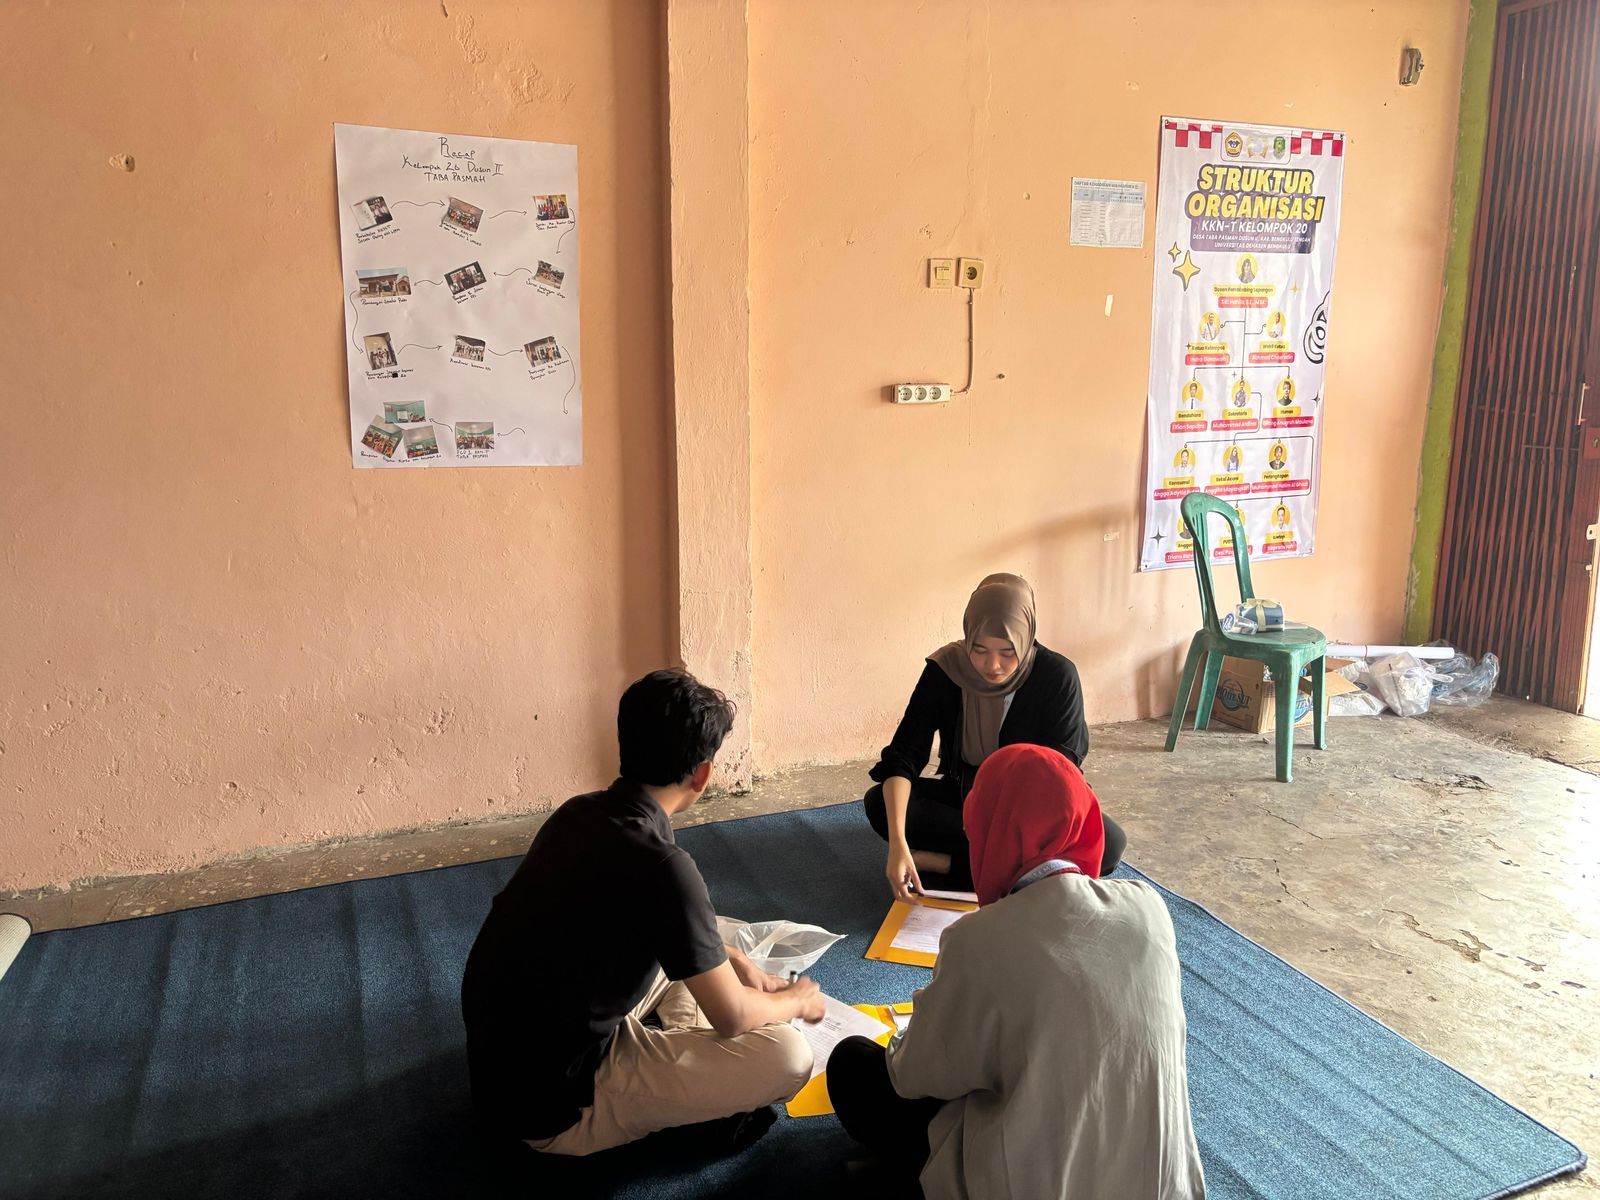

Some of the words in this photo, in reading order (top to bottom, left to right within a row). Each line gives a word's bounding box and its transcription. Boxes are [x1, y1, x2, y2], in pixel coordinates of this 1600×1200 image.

[437, 136, 476, 159] Recap
[467, 160, 491, 173] Dusun
[424, 171, 449, 182] TABA
[452, 171, 486, 183] PASMAH
[1199, 166, 1314, 194] STRUKTUR
[1187, 192, 1324, 221] ORGANISASI
[1201, 219, 1238, 232] KKN-T
[1238, 220, 1294, 234] KELOMPOK
[1295, 223, 1308, 234] 20
